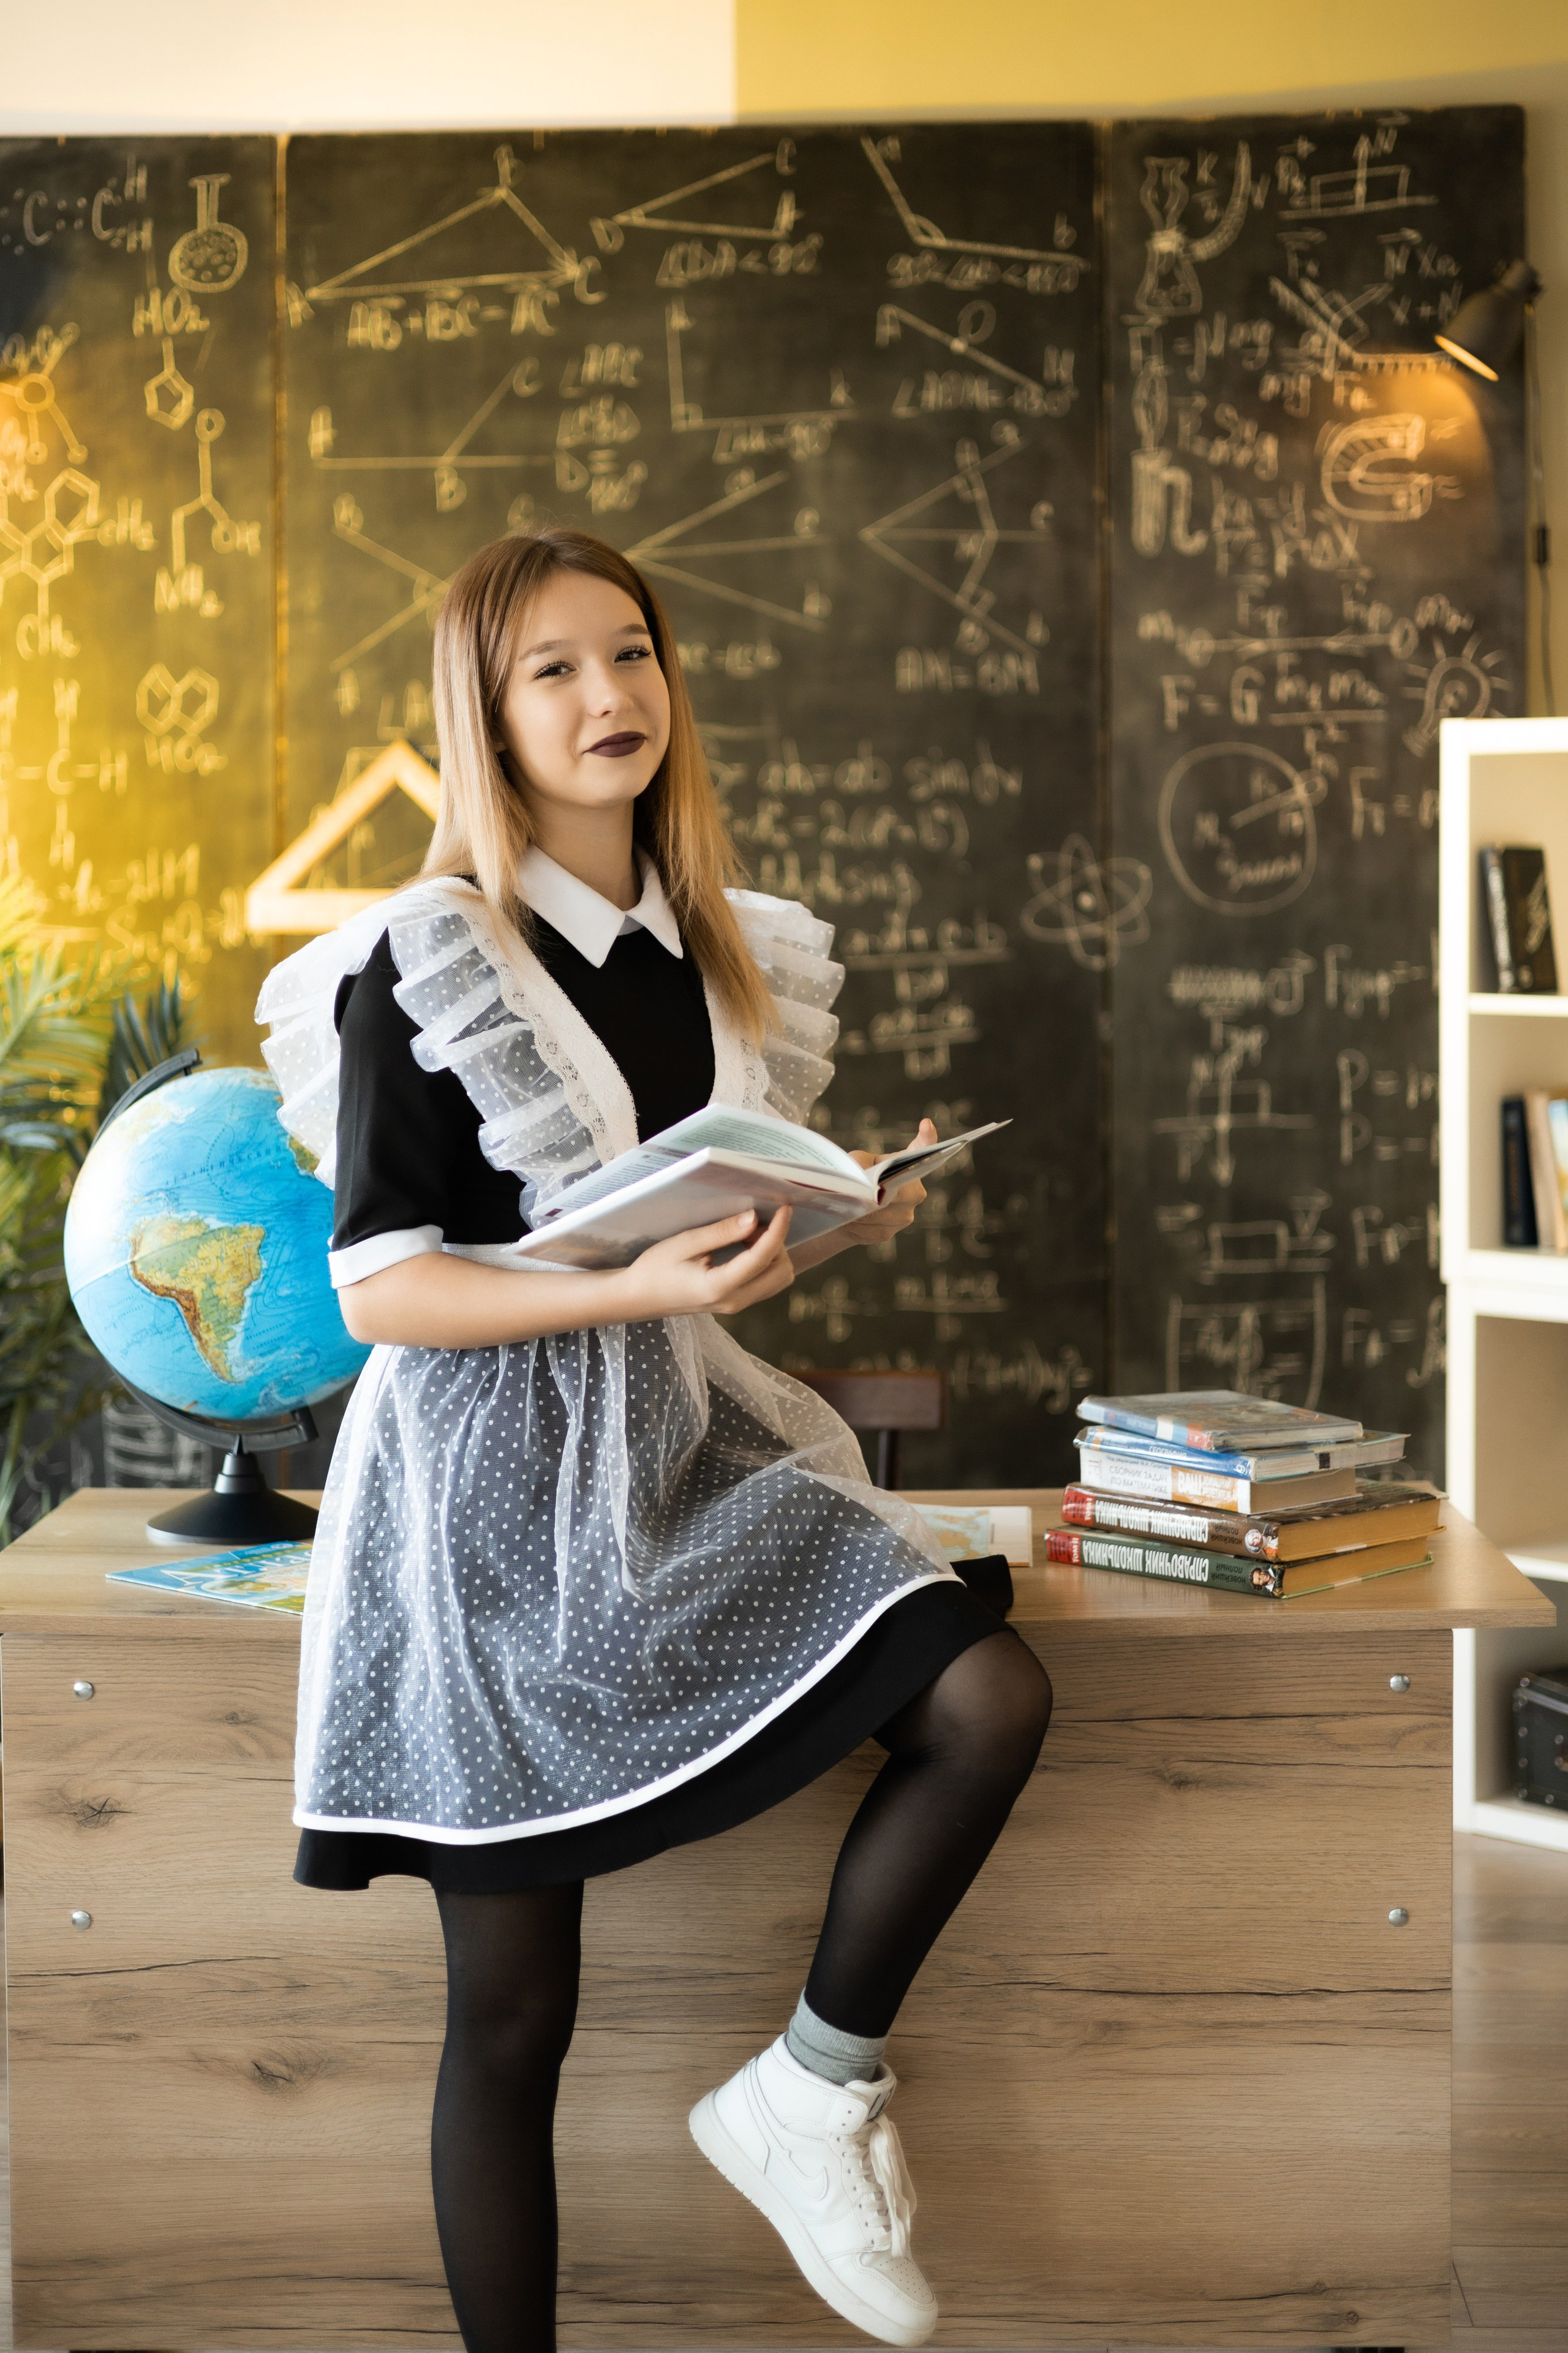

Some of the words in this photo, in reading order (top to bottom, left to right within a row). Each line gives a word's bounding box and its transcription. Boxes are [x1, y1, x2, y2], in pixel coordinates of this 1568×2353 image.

[1149, 1446, 1187, 1457] ГЕОГРАФИЯ
[1109, 1465, 1142, 1478] СБОРНИК
[1143, 1471, 1168, 1482] ЗАДАЧ
[1110, 1476, 1121, 1485] ПО
[1122, 1478, 1168, 1494] МАТЕМАТИКЕ
[1178, 1471, 1202, 1495] ВАШ
[1094, 1500, 1150, 1532] ШКОЛЬНИКА
[1150, 1509, 1209, 1544] СПРАВОЧНИК
[1214, 1524, 1239, 1535] ПОЛНЫЙ
[1210, 1535, 1243, 1546] НОВЕЙШИЙ
[1082, 1539, 1144, 1572] ШКОЛЬНИКА
[1145, 1549, 1209, 1582] СПРАВОЧНИК
[1215, 1562, 1243, 1573] ПОЛНЫЙ
[1211, 1572, 1246, 1584] НОВЕЙШИЙ
